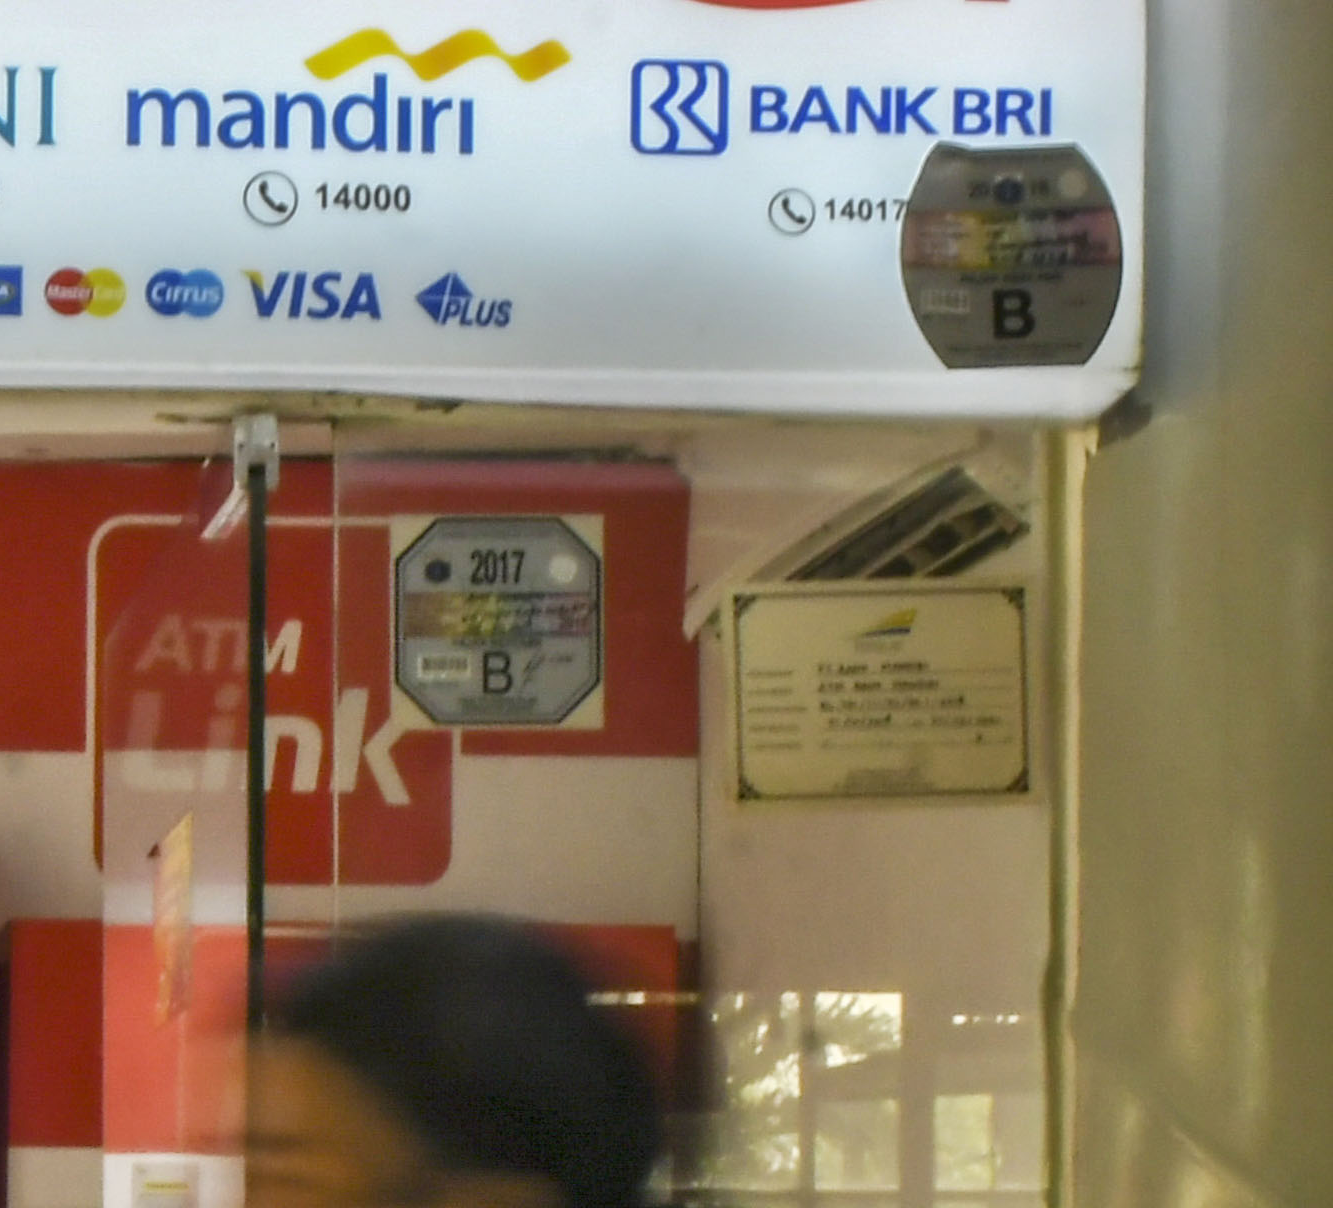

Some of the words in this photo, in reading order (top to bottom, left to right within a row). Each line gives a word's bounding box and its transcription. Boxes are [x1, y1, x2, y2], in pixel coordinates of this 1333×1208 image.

[126, 72, 474, 155] mandiri
[750, 86, 939, 134] BANK
[953, 88, 1052, 136] BRI
[315, 183, 412, 212] 14000
[241, 270, 381, 320] VISA
[440, 298, 513, 327] PLUS
[993, 288, 1036, 339] B
[470, 549, 525, 584] 2017
[483, 652, 513, 694] B
